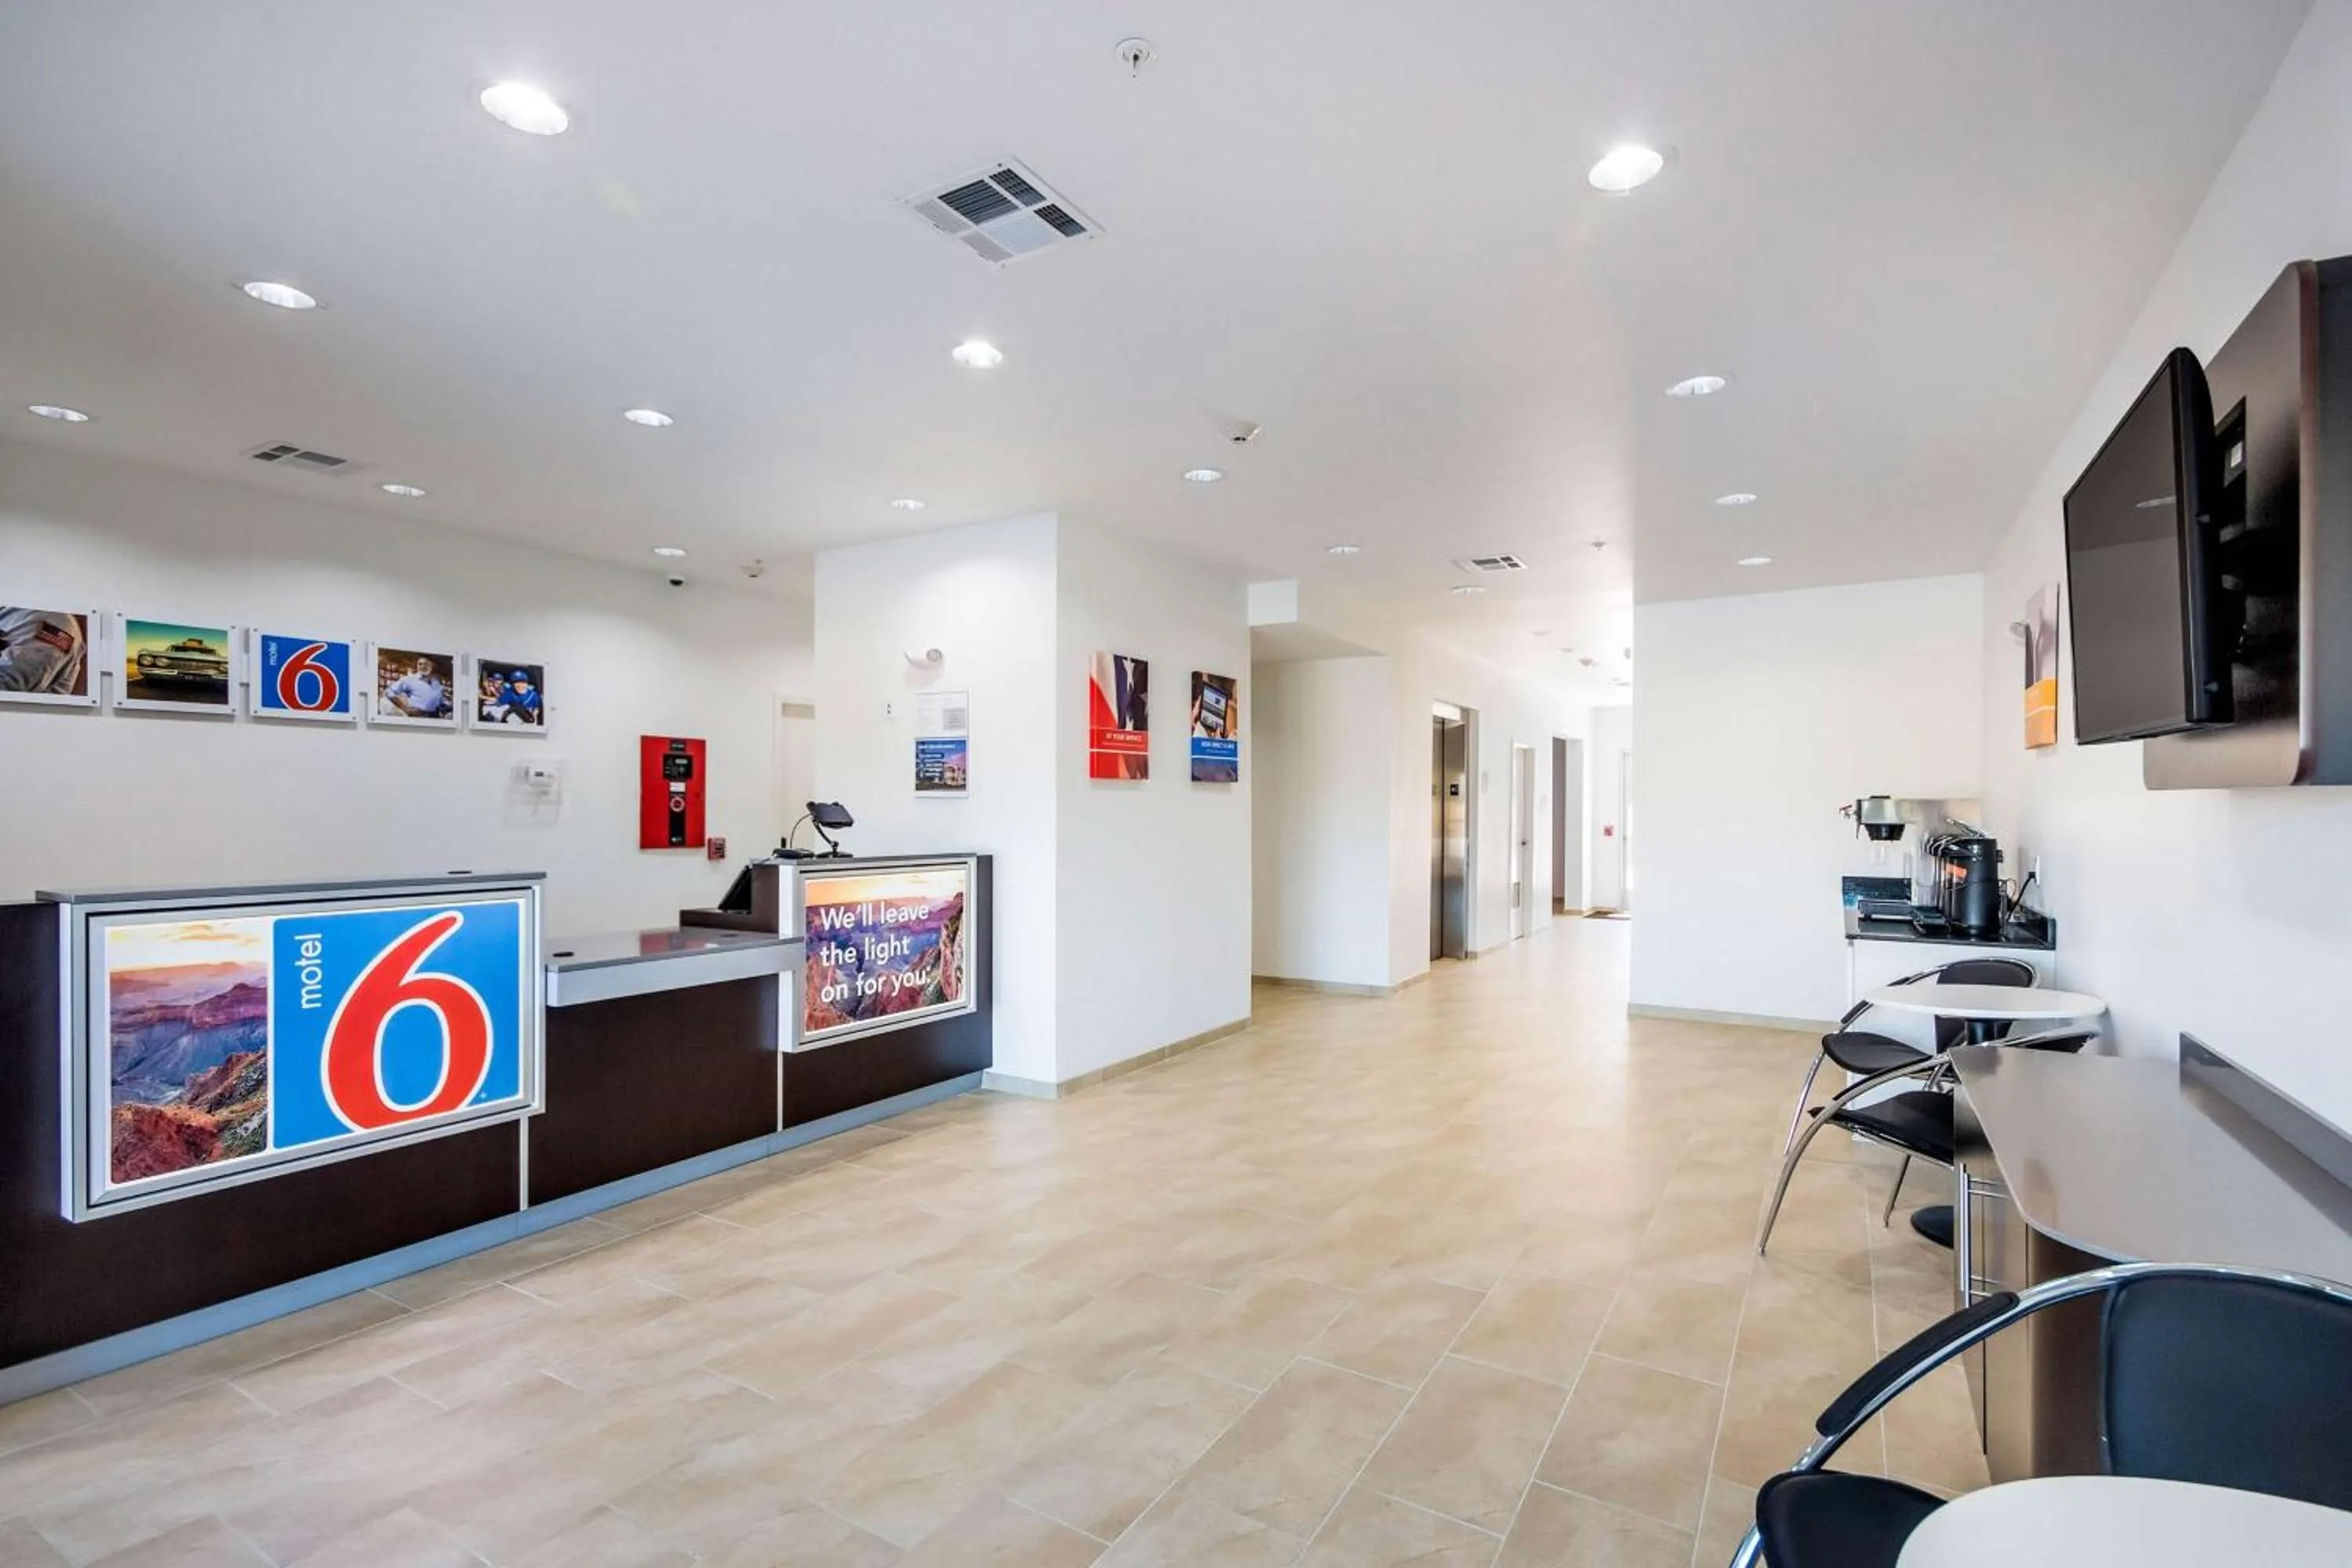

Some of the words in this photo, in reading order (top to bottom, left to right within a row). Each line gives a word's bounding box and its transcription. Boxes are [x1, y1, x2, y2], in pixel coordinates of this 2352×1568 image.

[277, 643, 339, 712] 6
[820, 902, 873, 931] We'll
[880, 901, 929, 924] leave
[820, 942, 856, 966] the
[865, 935, 910, 965] light
[821, 983, 848, 1003] on
[855, 971, 887, 996] for
[294, 934, 322, 1009] motel
[321, 910, 494, 1132] 6
